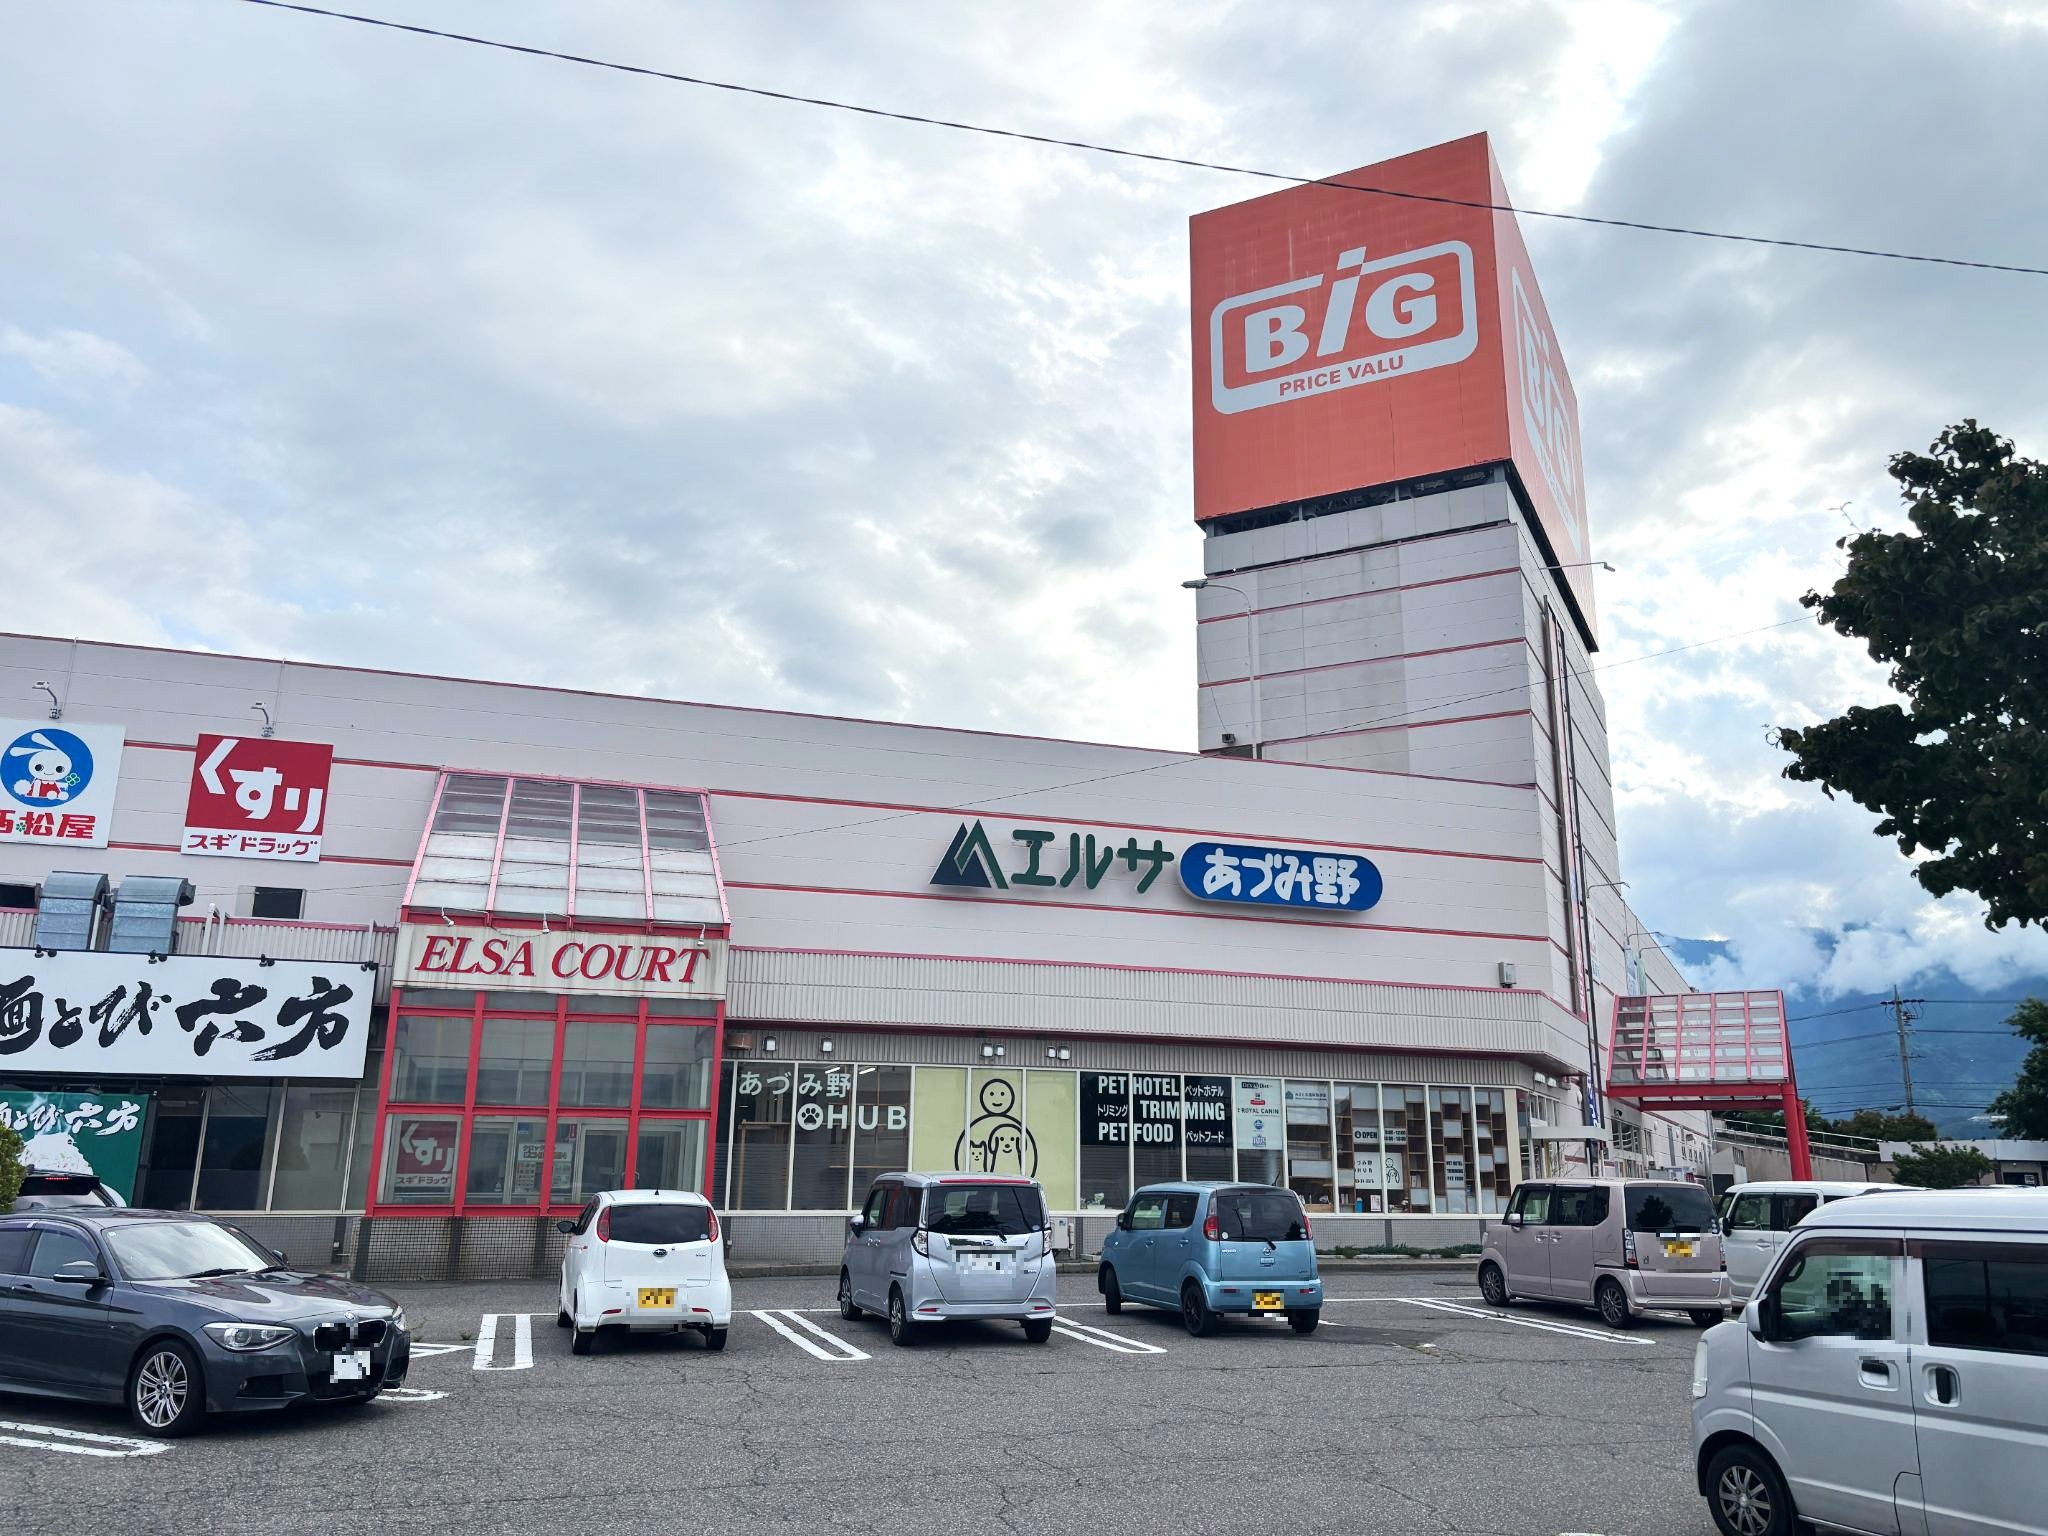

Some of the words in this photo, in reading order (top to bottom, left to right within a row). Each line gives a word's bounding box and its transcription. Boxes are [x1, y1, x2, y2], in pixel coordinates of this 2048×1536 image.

[1278, 370, 1342, 397] PRICE
[1347, 354, 1405, 381] VALU
[199, 738, 324, 833] くすり
[1011, 828, 1175, 894] エルサ
[1203, 847, 1360, 905] あづみ野
[414, 935, 537, 977] ELSA
[550, 942, 711, 983] COURT
[738, 1071, 851, 1098] あづみ野
[1098, 1075, 1127, 1095] PET
[1132, 1076, 1180, 1096] HOTEL
[1184, 1085, 1224, 1097] ペットホテル
[827, 1104, 907, 1130] HUB
[1097, 1104, 1128, 1118] トリミング
[1139, 1099, 1226, 1121] TRIMMING
[1098, 1121, 1128, 1142] PET
[1133, 1123, 1174, 1143] FOOD
[1186, 1131, 1225, 1143] ペットフード
[401, 1123, 456, 1172] くすり
